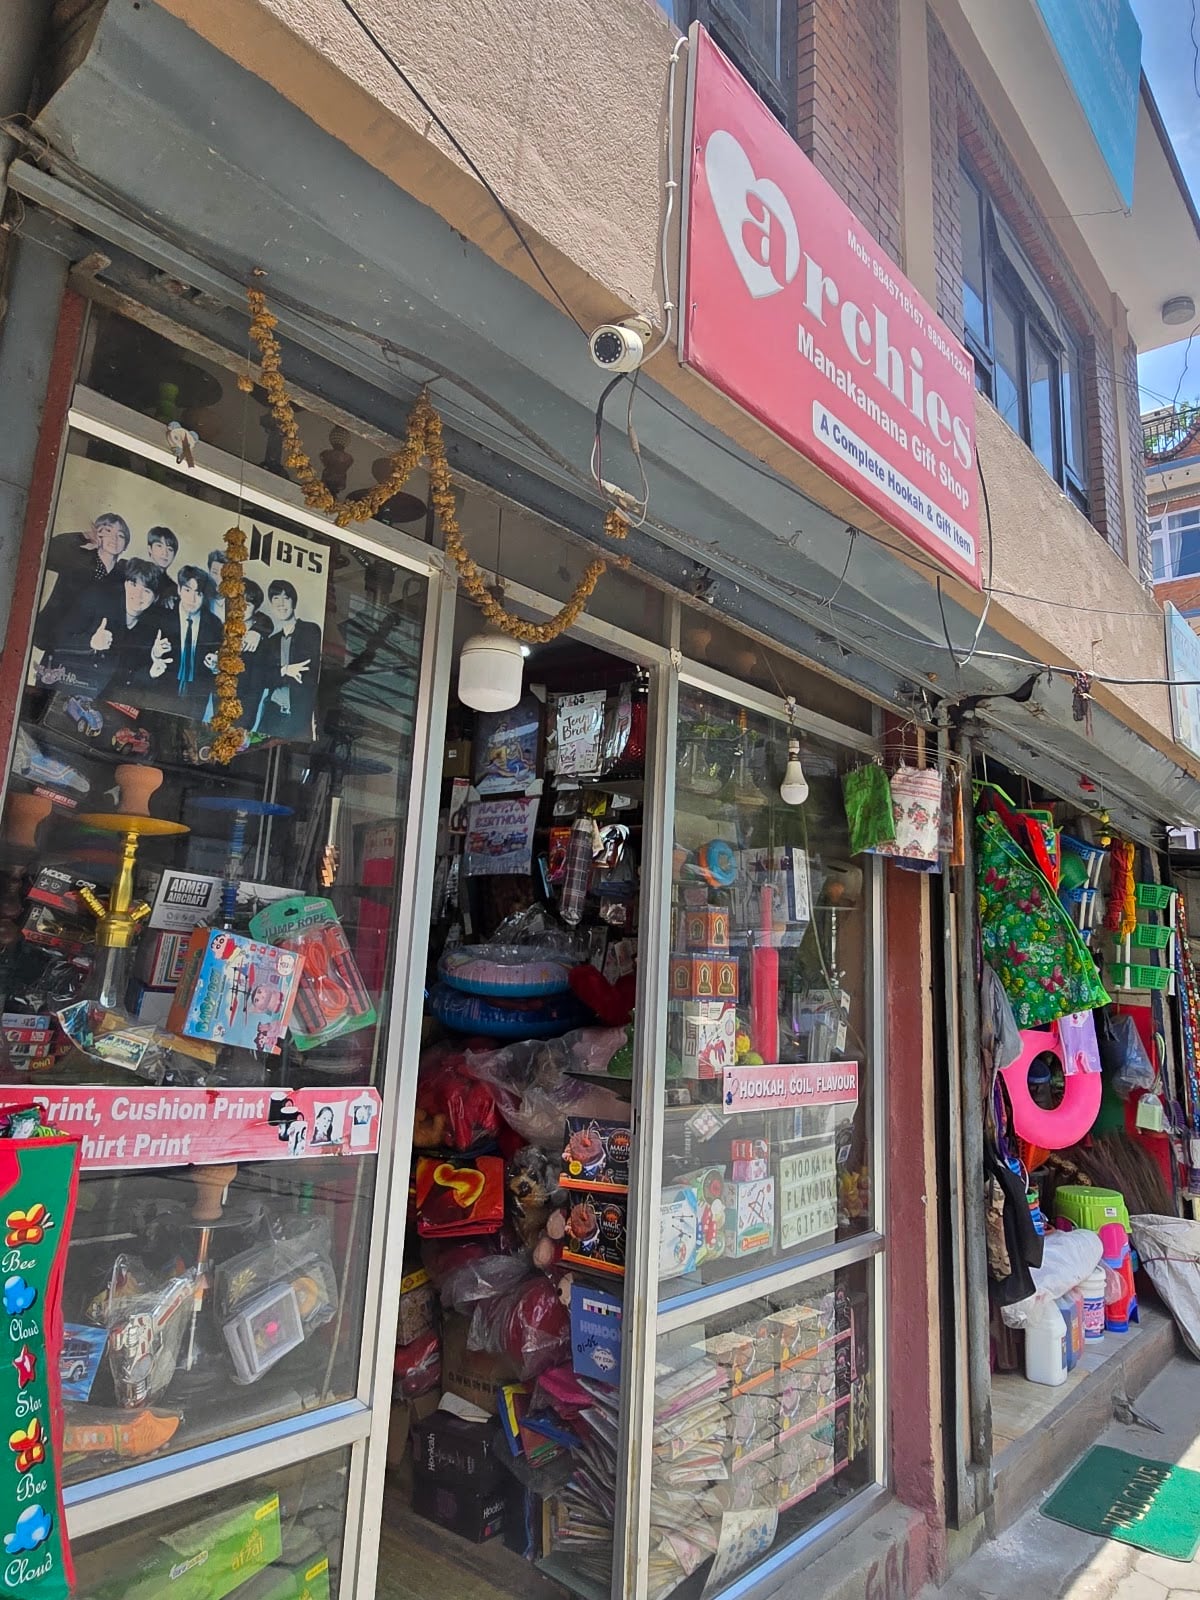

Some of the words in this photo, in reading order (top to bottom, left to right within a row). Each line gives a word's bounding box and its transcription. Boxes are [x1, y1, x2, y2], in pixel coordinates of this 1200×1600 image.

[847, 229, 871, 269] Mob:
[798, 323, 908, 450] Manakamana
[911, 435, 936, 478] Gift
[939, 463, 969, 510] Shop
[820, 413, 830, 437] A
[832, 423, 885, 482] Complete
[887, 470, 924, 515] Hookah
[926, 505, 934, 523] &
[935, 511, 952, 538] Gift
[952, 525, 972, 554] item
[276, 539, 324, 575] BTS
[475, 814, 529, 828] BIRTHDAY
[40, 867, 72, 884] MODEL
[171, 878, 209, 896] ARMED
[167, 891, 207, 906] AIRCRAFT
[263, 920, 295, 940] JUMP
[296, 911, 327, 929] ROPE
[739, 1079, 787, 1100] HOOKAH,
[789, 1077, 815, 1097] COIL,
[816, 1074, 856, 1094] FLAVOUR
[111, 1096, 206, 1121] Cushion
[213, 1097, 265, 1120] Print
[81, 1134, 126, 1159] hirt
[133, 1133, 193, 1158] Print
[787, 1178, 832, 1211] FLAVOUR
[797, 1209, 822, 1236] GIFT
[1, 1249, 37, 1274] Bee
[9, 1314, 39, 1342] Cloud
[16, 1472, 48, 1502] Bee
[1100, 1464, 1173, 1530] WELCOME
[4, 1551, 54, 1589] Cloud
